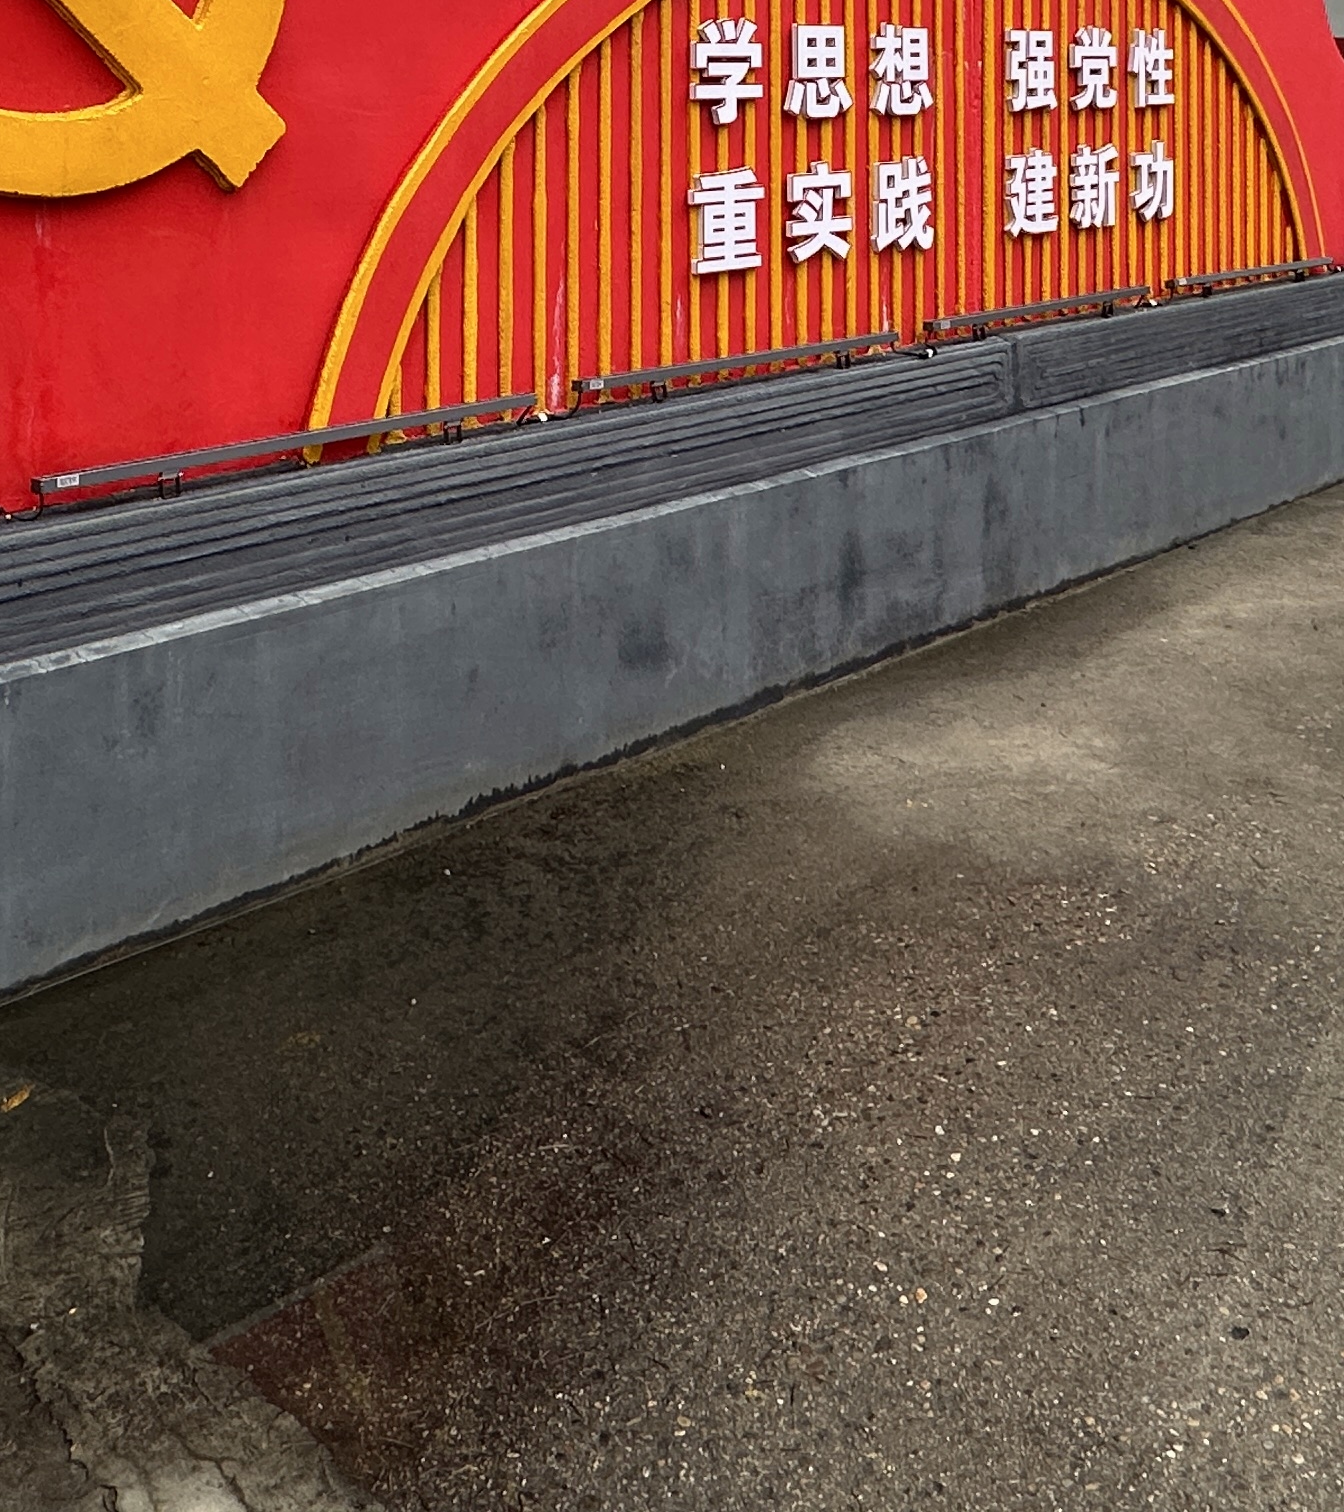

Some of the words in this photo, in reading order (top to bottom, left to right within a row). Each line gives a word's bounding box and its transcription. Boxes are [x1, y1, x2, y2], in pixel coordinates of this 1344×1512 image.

[689, 17, 934, 125] 学思想
[1004, 25, 1175, 113] 强党性
[688, 155, 935, 276] 重实践
[1004, 139, 1174, 238] 建新功
